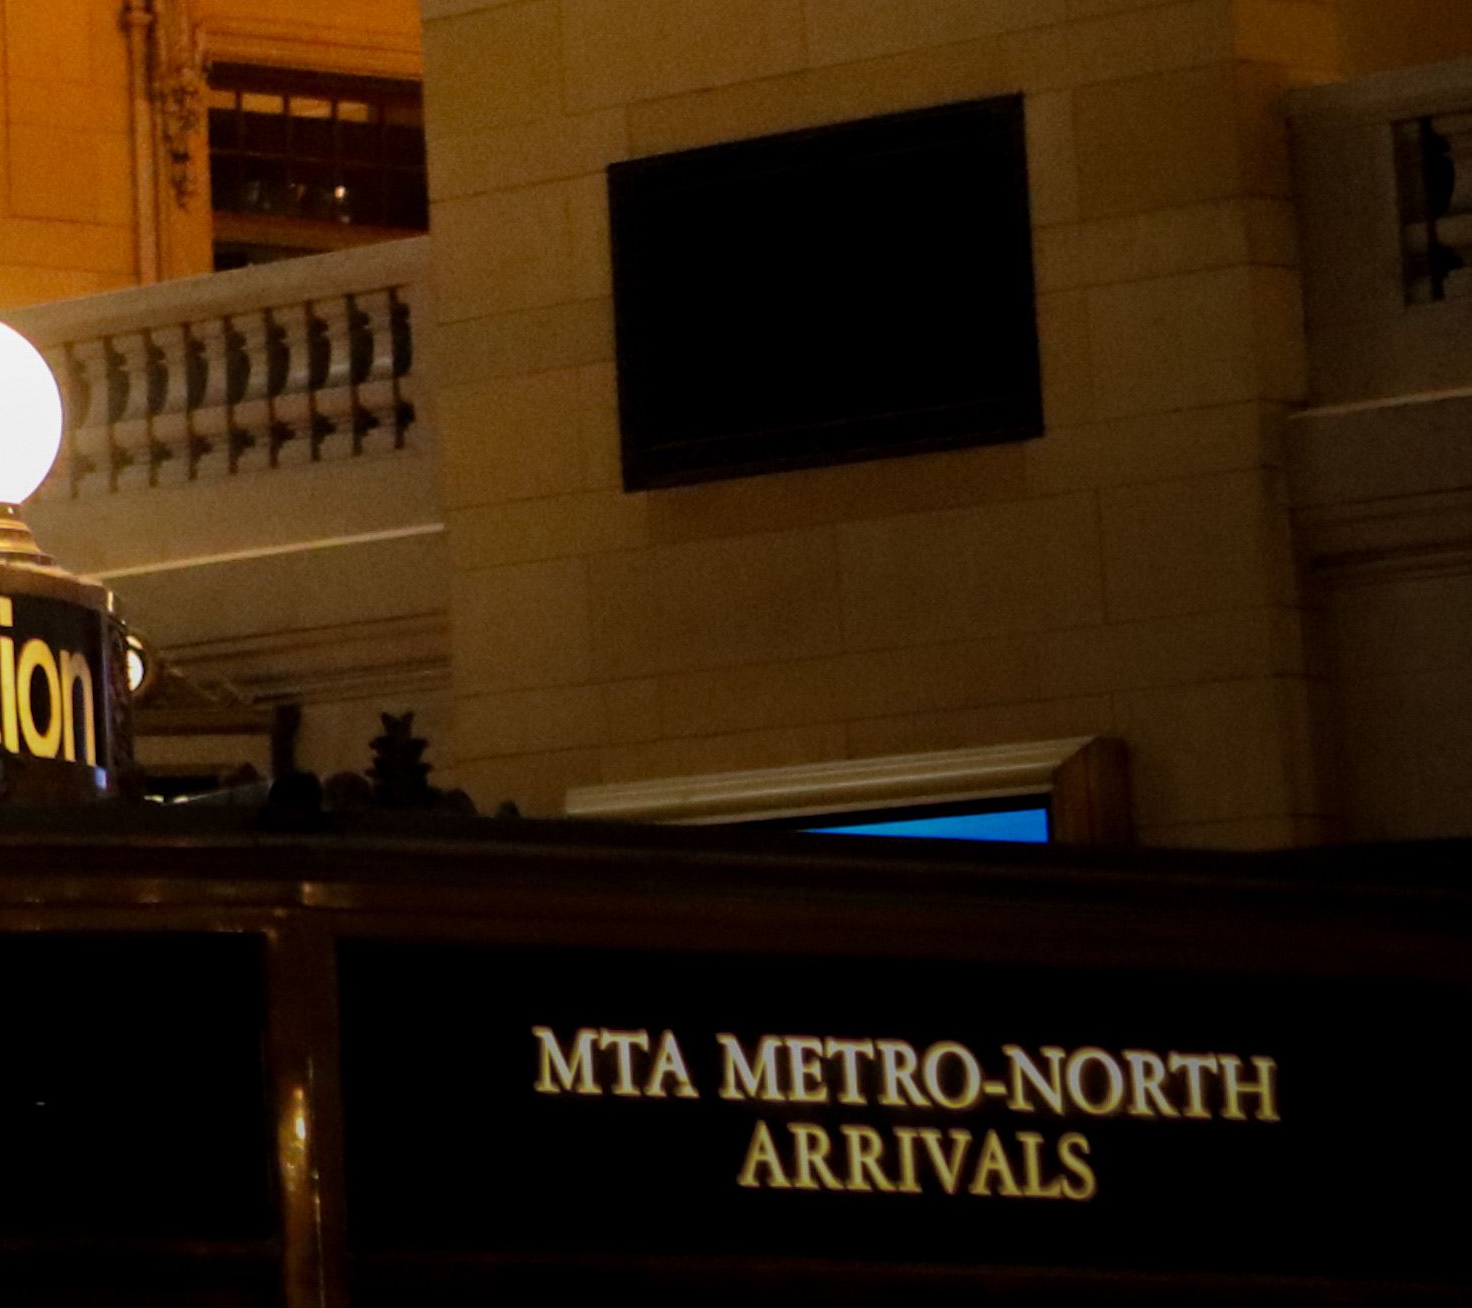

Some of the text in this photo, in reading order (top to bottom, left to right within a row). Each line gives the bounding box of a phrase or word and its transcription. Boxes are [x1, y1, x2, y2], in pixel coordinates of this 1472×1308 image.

[532, 1026, 1283, 1122] MTA METRO-NORTH
[737, 1119, 1098, 1201] ARRIVALS
